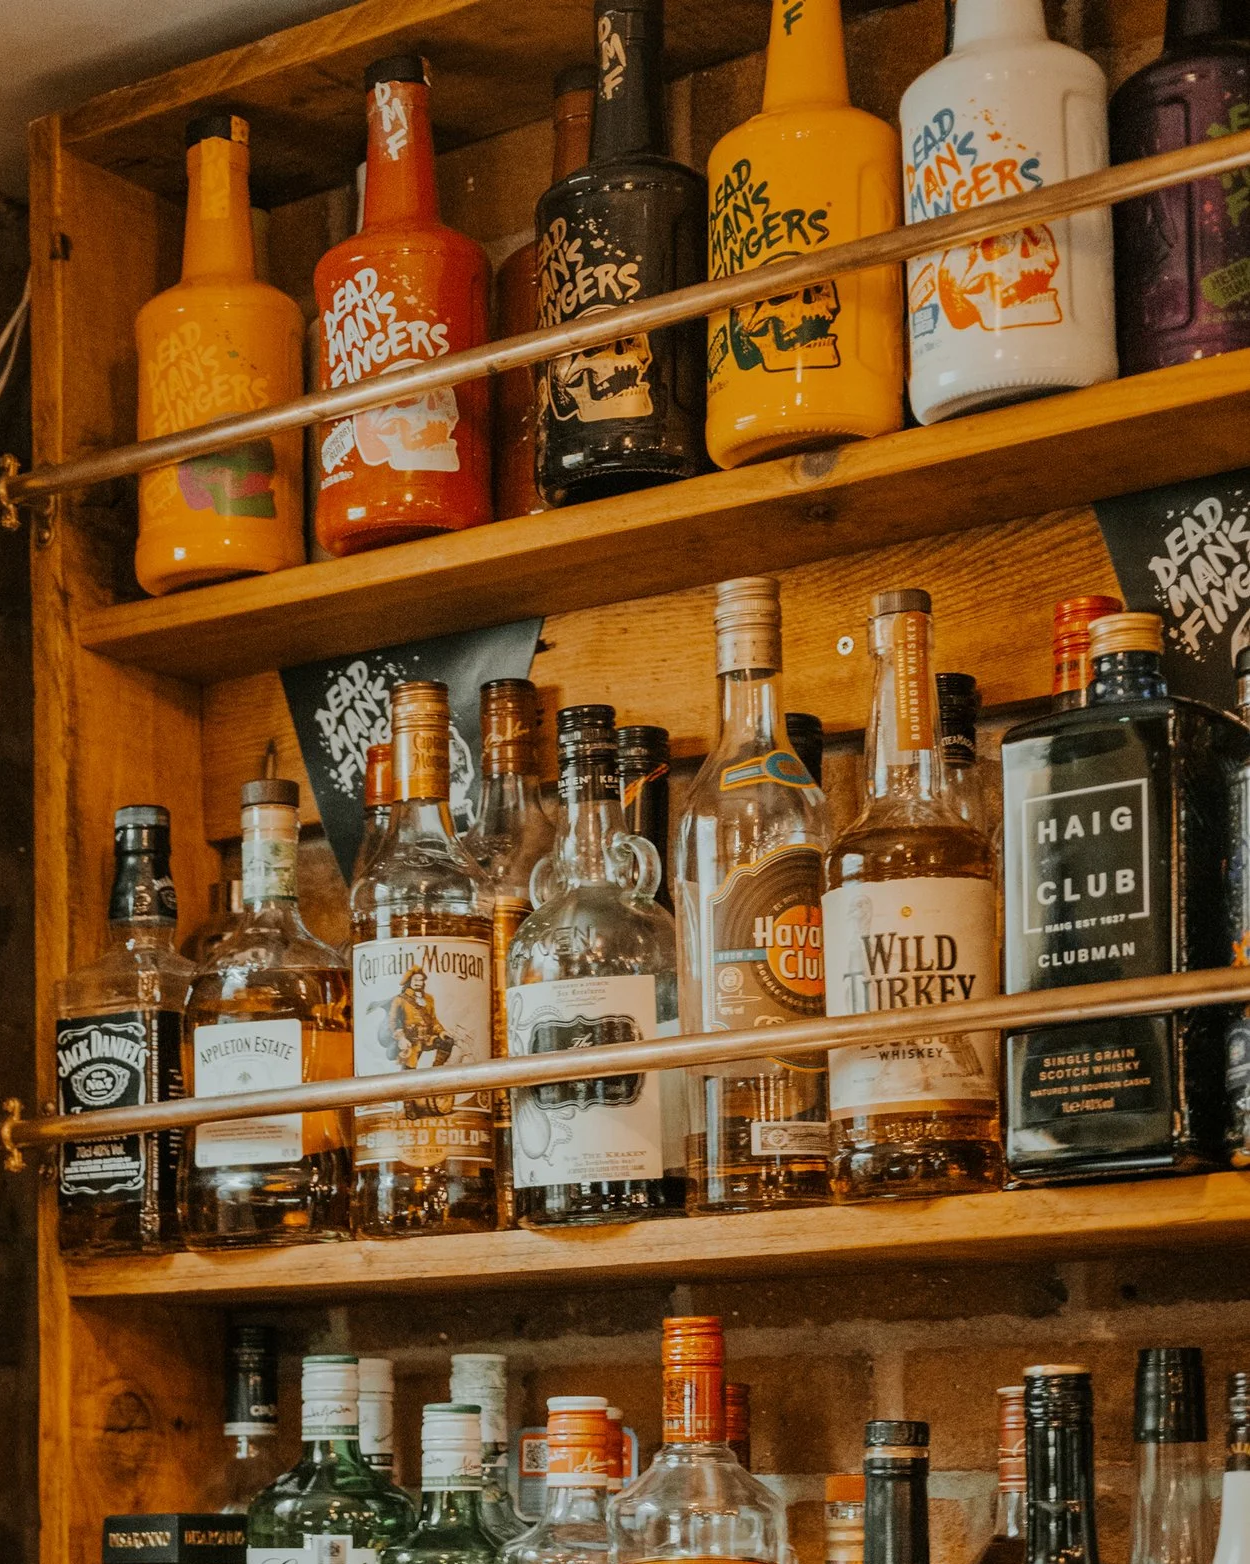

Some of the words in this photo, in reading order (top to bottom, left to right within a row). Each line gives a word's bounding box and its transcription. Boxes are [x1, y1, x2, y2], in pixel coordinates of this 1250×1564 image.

[905, 107, 956, 194] DEAD
[710, 158, 751, 240] DEAD
[933, 157, 1044, 217] NGERS
[711, 181, 770, 269] MAN'S
[324, 267, 378, 340] DEAD
[328, 290, 397, 368] MAN'S
[148, 321, 201, 386] DEAD
[330, 320, 450, 388] FINGERS
[153, 372, 270, 436] FINGERS
[1147, 497, 1223, 589] DEAD
[1179, 562, 1250, 651] FING
[906, 617, 918, 675] WHISKEY
[315, 660, 368, 738] DEAD
[909, 679, 921, 741] BOURBON
[337, 713, 392, 791] FING
[1037, 806, 1133, 845] HAIG
[1036, 869, 1136, 906] CLUB
[753, 916, 823, 948] Hava
[861, 932, 958, 976] WILD
[1045, 918, 1073, 933] HAIG
[1075, 917, 1097, 930] EST
[359, 946, 415, 986] Captain
[417, 944, 484, 981] Morgan
[1038, 941, 1136, 968] CLUBMAN
[57, 1038, 92, 1078] JACK
[90, 1030, 151, 1073] DANIEL'S
[199, 1036, 251, 1067] APPLETON
[254, 1036, 294, 1061] ESTATE
[878, 1047, 944, 1061] WHISKEY
[1039, 1065, 1090, 1081] SCOTCH
[1092, 1060, 1140, 1075] WHISKY
[1043, 1053, 1091, 1068] SINGLE
[1094, 1048, 1135, 1062] GRAIN
[1122, 1076, 1151, 1088] CASKS
[435, 1128, 480, 1147] GOLD
